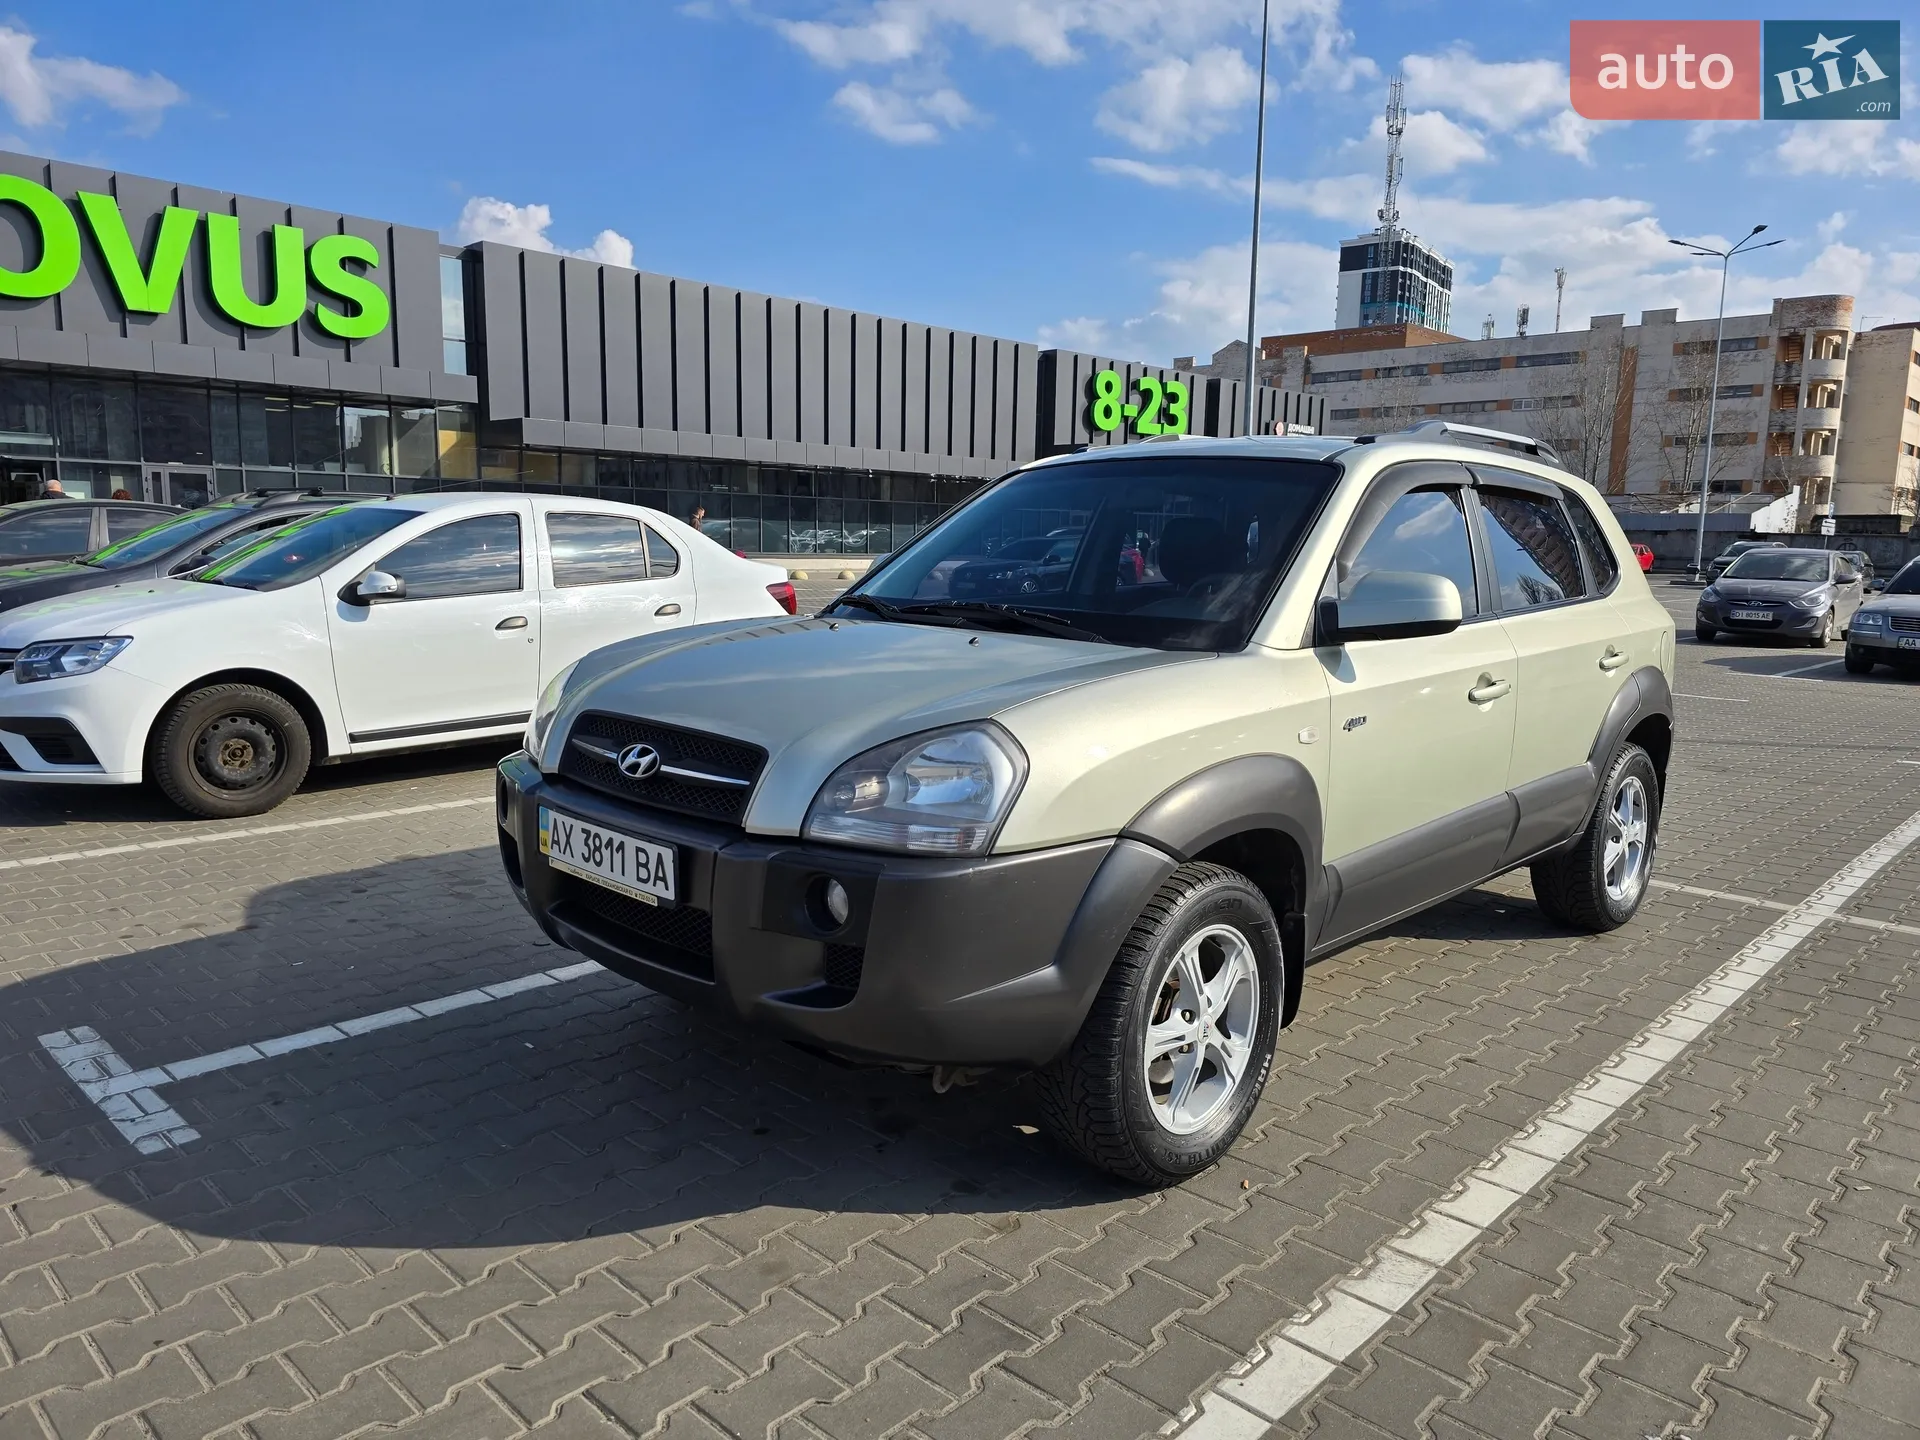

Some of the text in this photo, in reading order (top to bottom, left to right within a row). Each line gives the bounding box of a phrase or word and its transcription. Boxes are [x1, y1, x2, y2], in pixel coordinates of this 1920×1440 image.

[1090, 369, 1189, 435] 8-23
[1904, 638, 1917, 647] AA
[540, 836, 548, 848] UA
[550, 817, 669, 892] AX 3811 BA
